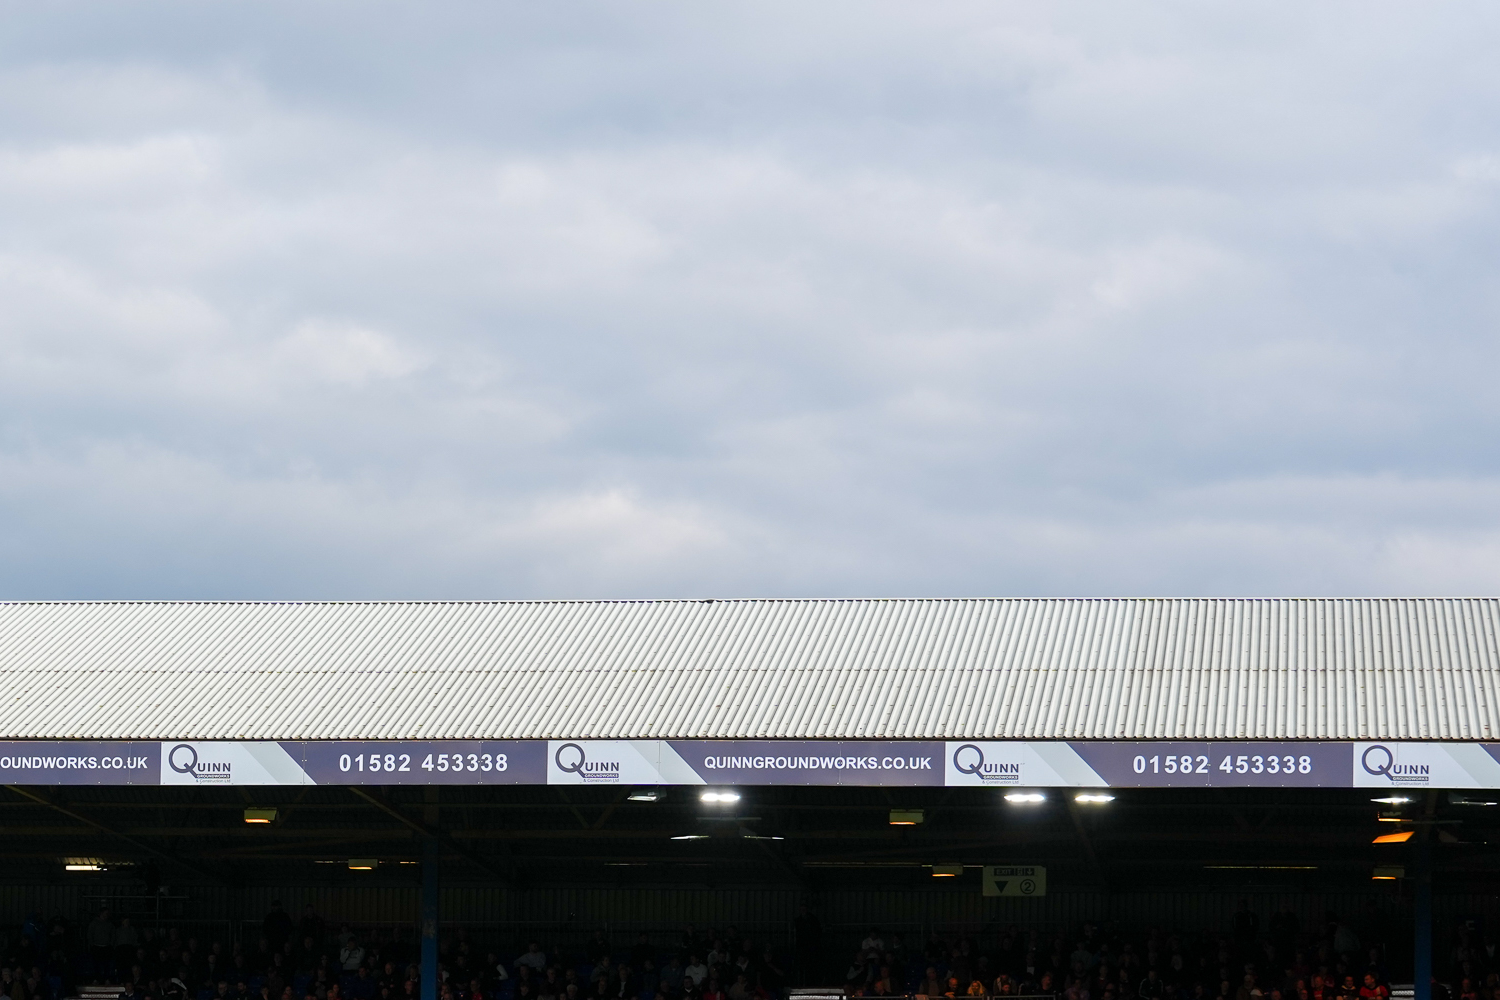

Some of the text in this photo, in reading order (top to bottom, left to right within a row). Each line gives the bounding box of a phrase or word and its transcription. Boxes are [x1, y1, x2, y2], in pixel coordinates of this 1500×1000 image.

[168, 743, 231, 777] QUINN
[339, 753, 509, 772] 01582 453338
[555, 742, 620, 777] QUINN
[704, 756, 932, 770] QUINNGROUNDWORKS.CO.UK
[953, 744, 1019, 779] QUINN
[1133, 755, 1312, 774] 01582 453338
[1361, 744, 1430, 781] QUINN
[1024, 881, 1032, 892] 2
